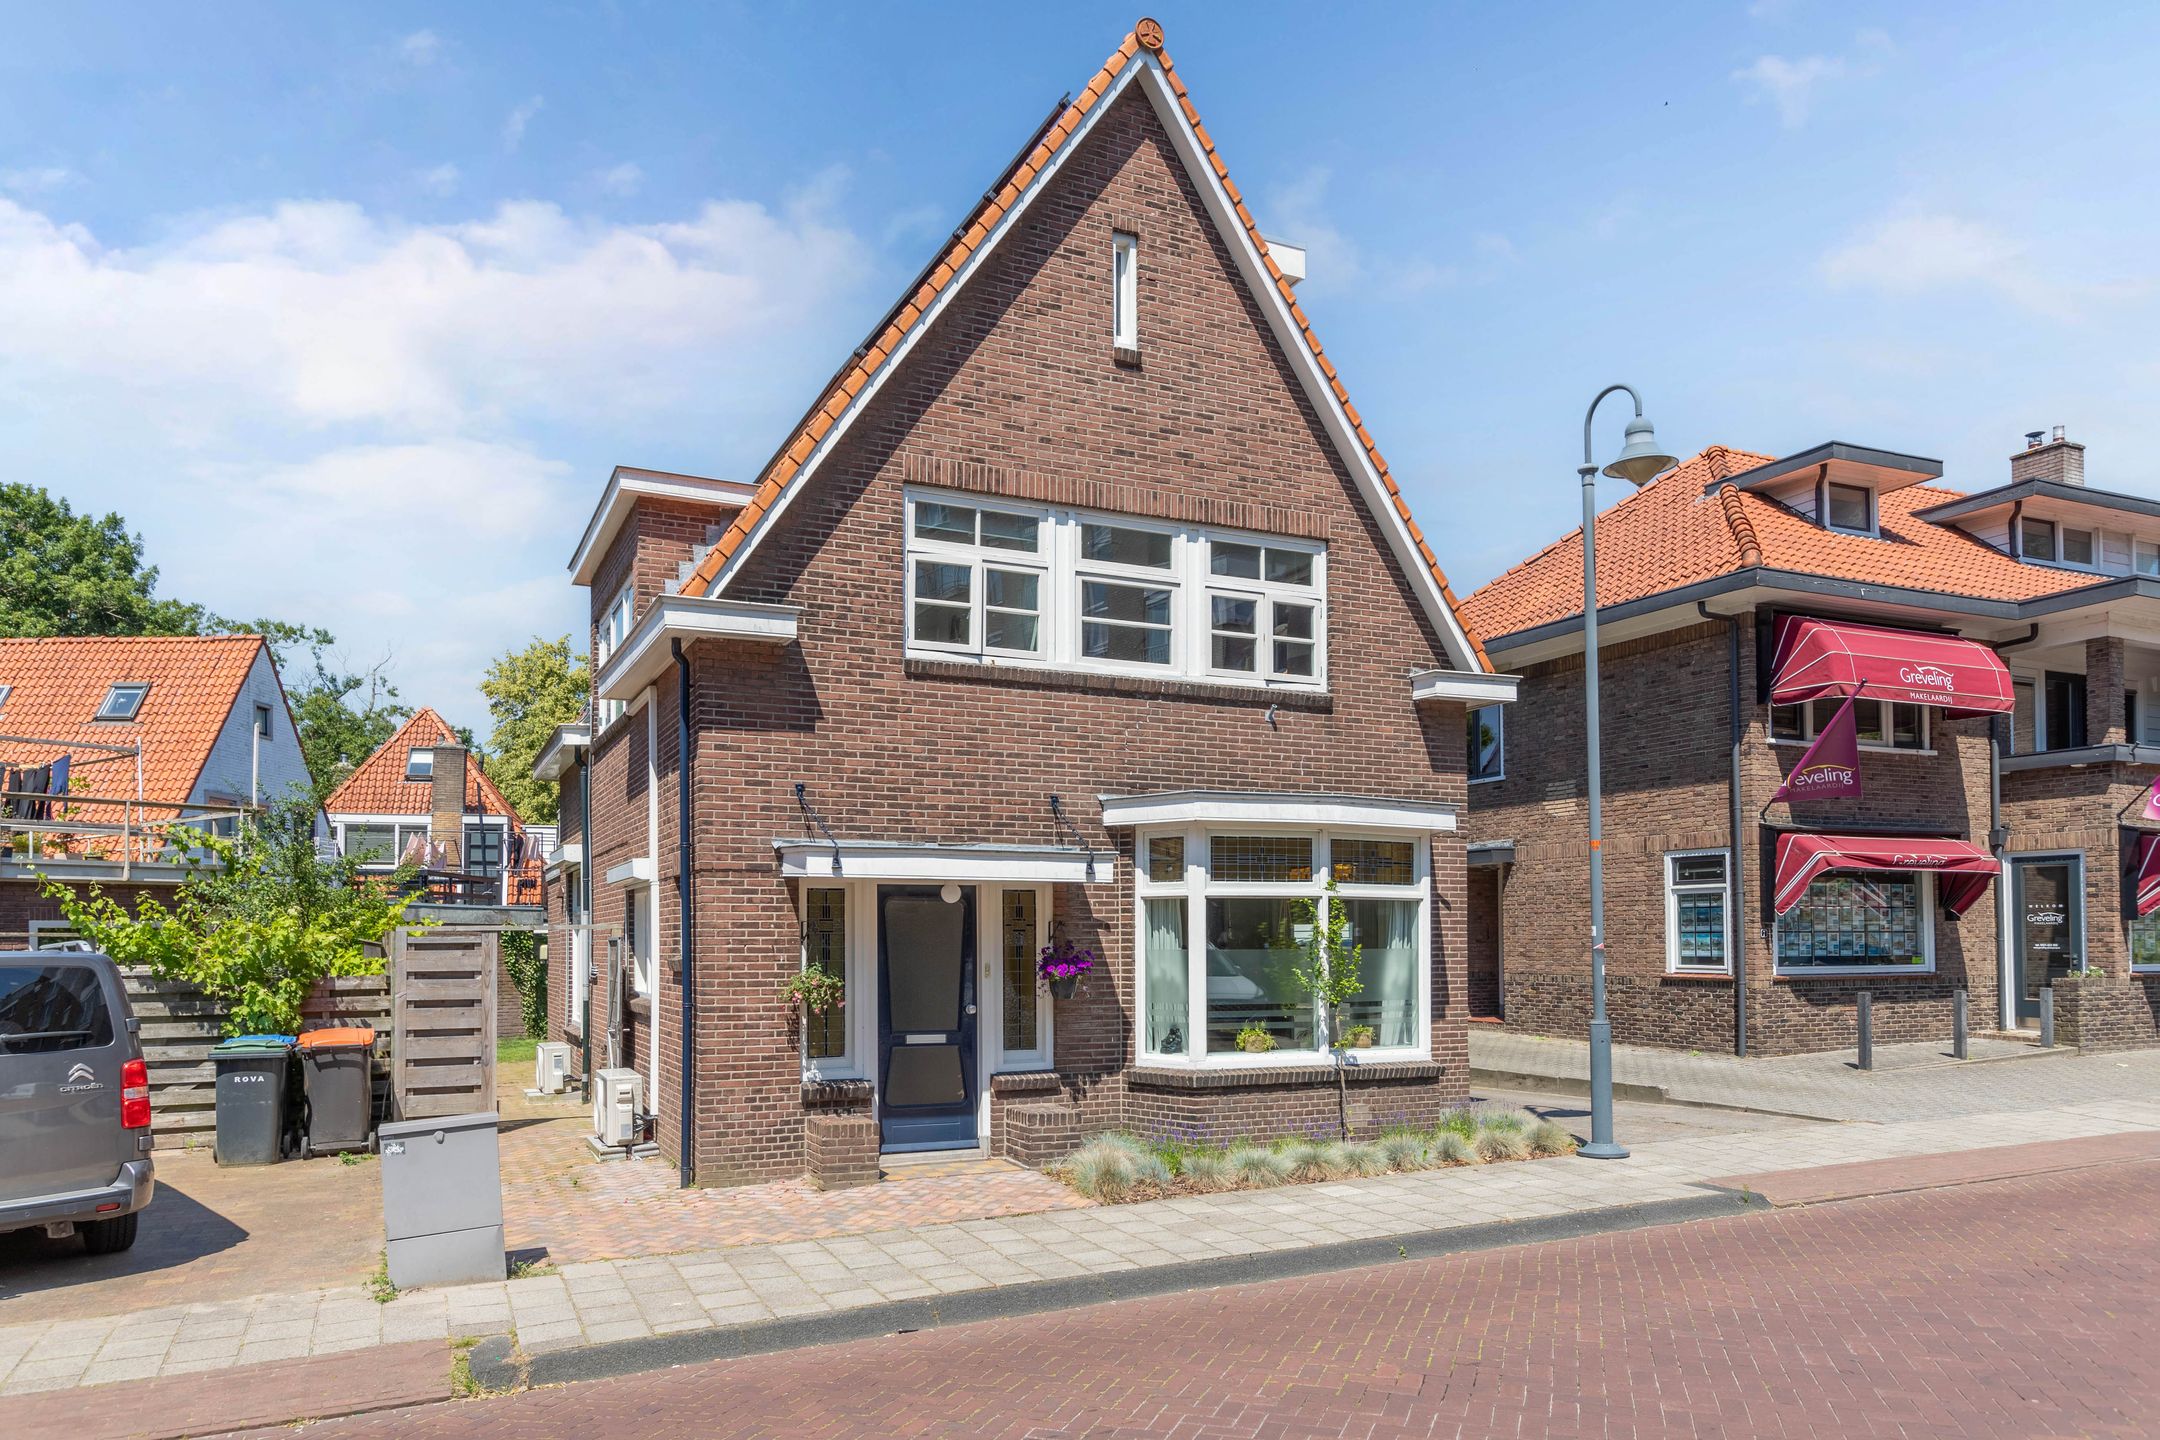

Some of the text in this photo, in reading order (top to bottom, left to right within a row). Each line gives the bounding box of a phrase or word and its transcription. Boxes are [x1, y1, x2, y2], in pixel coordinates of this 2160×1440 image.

[1900, 667, 1954, 691] Greveling
[1910, 692, 1953, 704] MAKELAARDIJ
[1794, 768, 1853, 785] eveling
[2026, 914, 2063, 923] Greveling
[234, 1075, 265, 1083] ROVA
